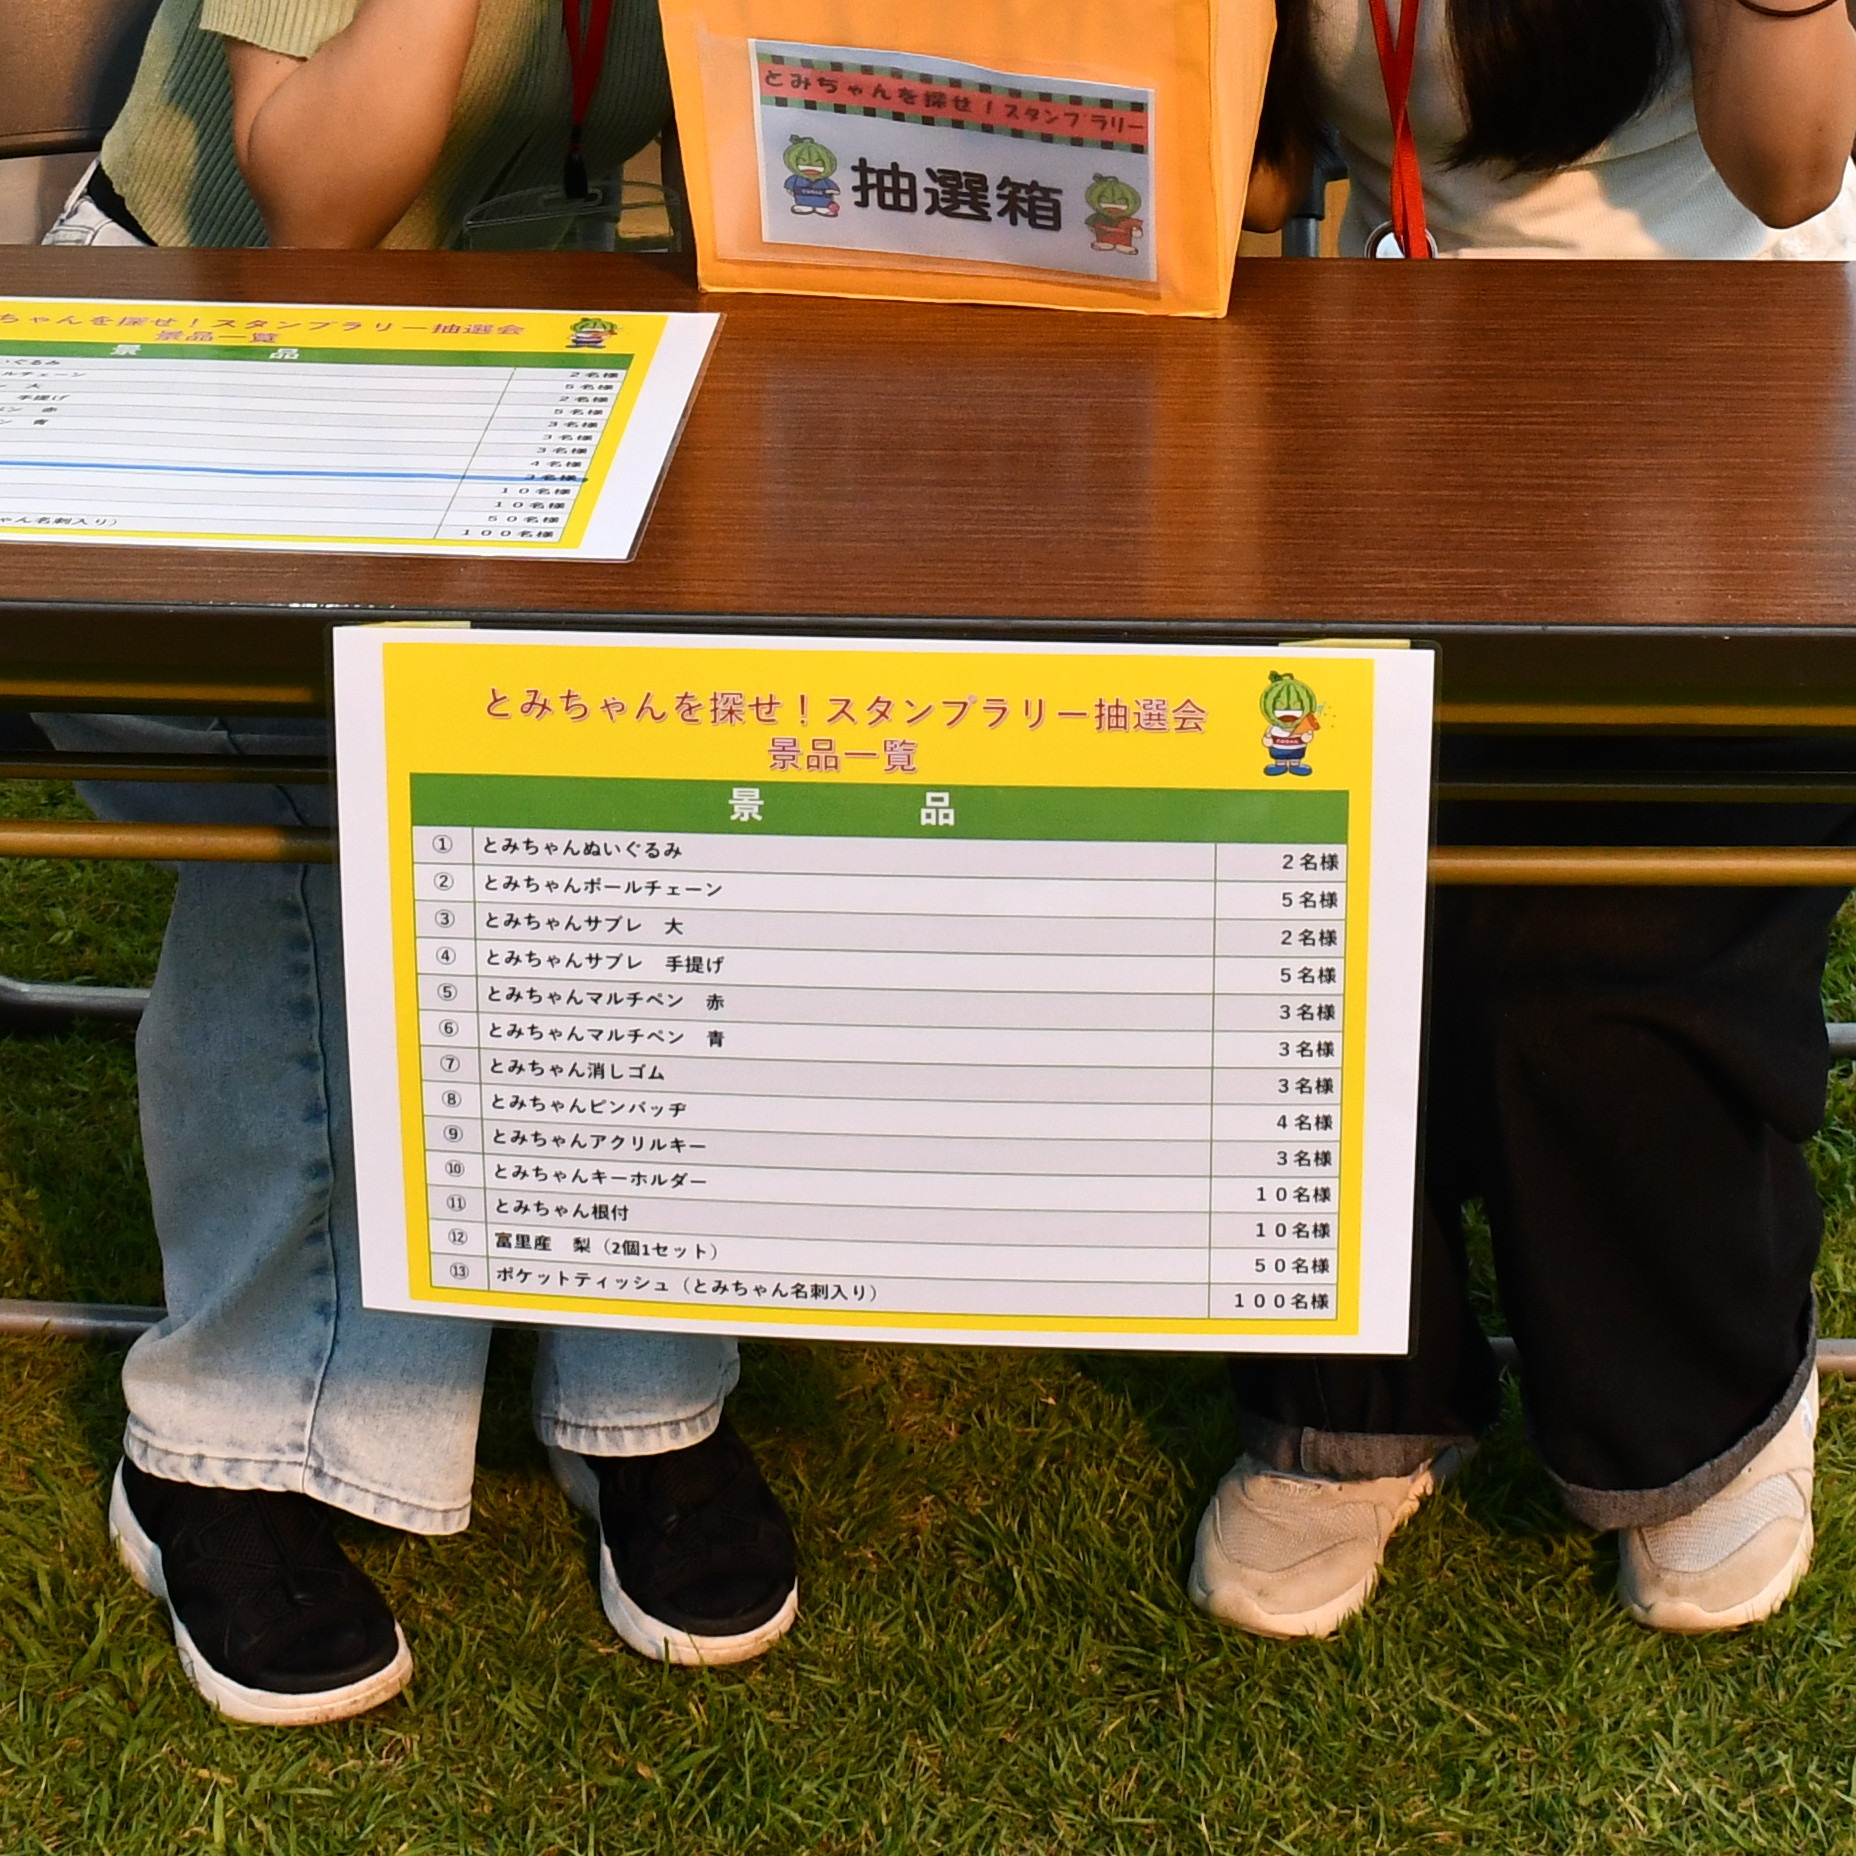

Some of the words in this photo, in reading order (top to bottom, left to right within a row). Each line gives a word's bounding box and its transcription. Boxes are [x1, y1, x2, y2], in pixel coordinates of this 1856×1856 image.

[850, 155, 1064, 232] 抽選箱
[484, 685, 1209, 734] とみちゃんを探せ！スタンプラリー抽選会
[767, 737, 919, 773] 景品一覧
[728, 787, 765, 823] 景
[920, 791, 956, 827] 品
[482, 836, 683, 861] とみちゃんぬいぐるみ
[1281, 853, 1339, 872] 2名様
[483, 873, 723, 897] とみちゃんボールチェーン
[1281, 891, 1338, 910] 5名様
[484, 910, 643, 933] とみちゃんサブレ
[663, 916, 685, 937] 大
[1280, 928, 1338, 948] 2名様
[485, 948, 643, 971] とみちゃんサブレ
[665, 955, 725, 975] 手提げ
[1279, 966, 1337, 985] 5名様
[487, 984, 684, 1009] とみちゃんマルチペン
[705, 992, 725, 1012] 赤
[1279, 1003, 1336, 1022] 3名様
[488, 1021, 684, 1046] とみちゃんマルチペン
[706, 1029, 725, 1048] 青
[1278, 1040, 1335, 1058] 3名様
[489, 1056, 666, 1082] とみちゃん消しゴム
[1277, 1077, 1334, 1095] 3名様
[491, 1092, 687, 1119] とみちゃんピンバッヂ
[1276, 1113, 1334, 1132] 4名様
[492, 1127, 706, 1154] とみちゃんアクリルキー
[1276, 1150, 1332, 1168] 3名様
[494, 1163, 707, 1188] とみちゃんキーホルダー
[1256, 1186, 1332, 1204] 10名様
[495, 1197, 629, 1223] とみちゃん根付
[1255, 1222, 1331, 1240] 10名様
[494, 1232, 553, 1253] 富里産
[572, 1236, 720, 1263] 梨（2個1セット）
[1254, 1257, 1330, 1275] 50名様
[496, 1267, 878, 1302] ポケットティッシュ（とみちゃん名刺入り）
[1233, 1292, 1329, 1311] 100名様
